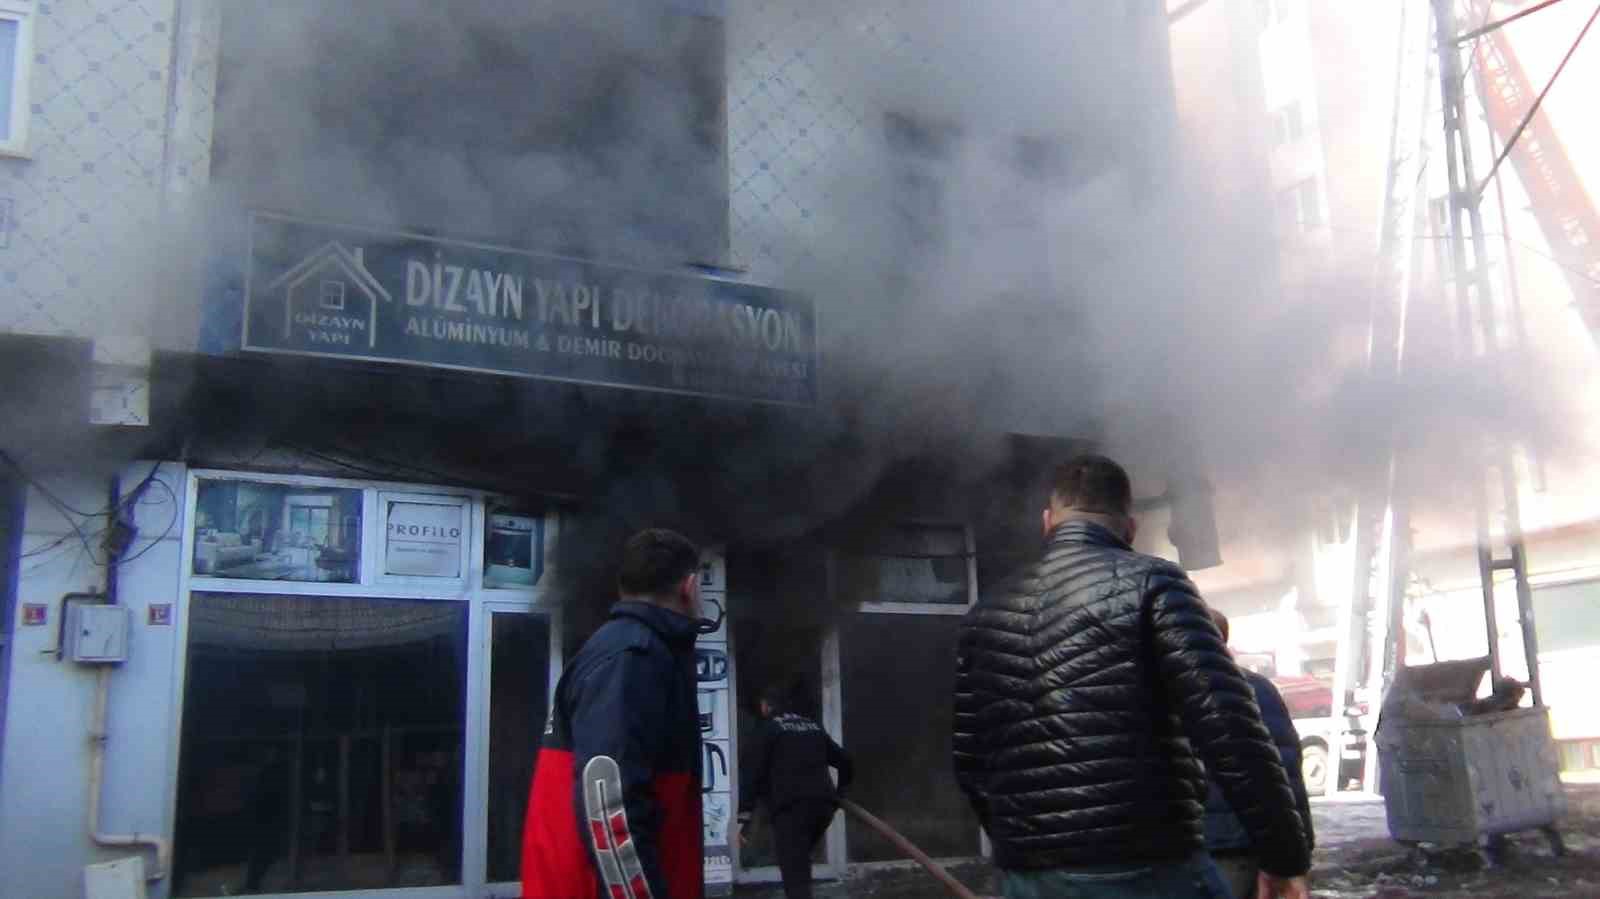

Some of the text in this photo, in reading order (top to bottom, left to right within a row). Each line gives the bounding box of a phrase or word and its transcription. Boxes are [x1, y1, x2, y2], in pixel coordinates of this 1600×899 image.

[406, 251, 523, 320] DİZAYN
[534, 276, 601, 329] YAPI
[295, 311, 366, 331] DİZAYN
[308, 329, 351, 345] YAPI
[404, 315, 529, 350] ALÜMİNYUM
[556, 334, 622, 360] DEMİR
